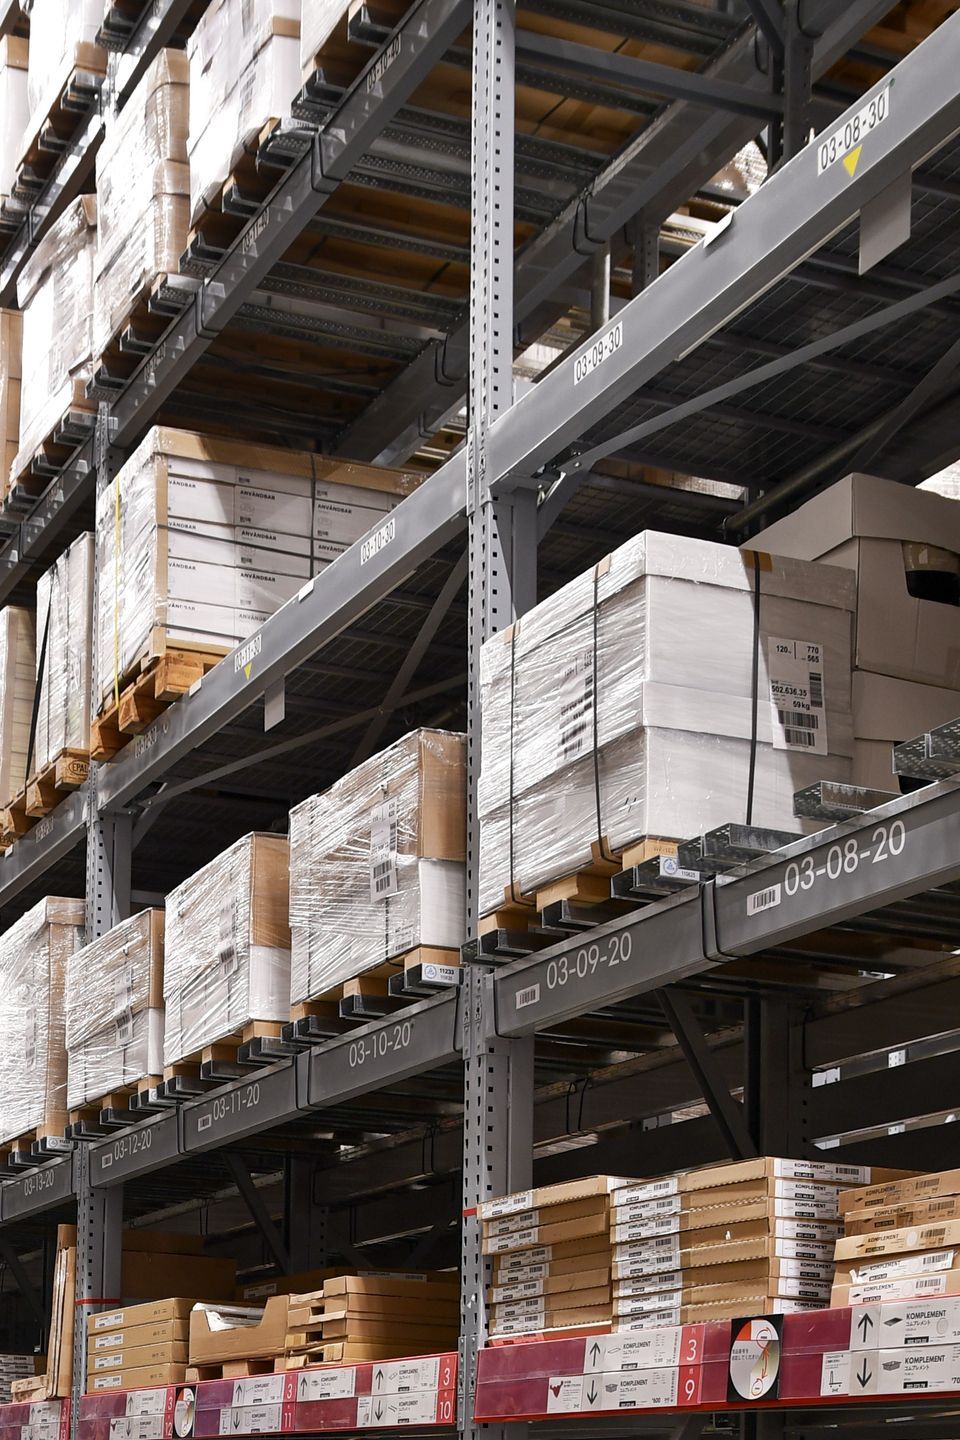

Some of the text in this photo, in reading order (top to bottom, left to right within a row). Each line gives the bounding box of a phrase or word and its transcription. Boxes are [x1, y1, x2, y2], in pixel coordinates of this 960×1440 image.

[821, 93, 885, 170] 03-08-30
[576, 326, 620, 381] 03-09-30
[362, 521, 394, 562] 03-10-30
[807, 645, 819, 654] 770
[784, 820, 906, 896] 03-08-20
[547, 932, 632, 989] 03-09-20
[439, 968, 455, 976] 11233
[349, 1022, 411, 1068] 03-10-20
[213, 1083, 260, 1121] 03-11-20
[114, 1129, 152, 1161] 03-12-20
[874, 1207, 907, 1217] KOMPLEMENT
[867, 1234, 899, 1243] KOMPLEMENT
[863, 1283, 894, 1292] KOMPLEMENT
[906, 1310, 946, 1320] KOMPLEMENT
[623, 1341, 651, 1349] KOMPLEMENT
[686, 1339, 697, 1361] 3
[904, 1355, 945, 1365] KOMPLEMENT
[443, 1367, 451, 1386] 3
[620, 1379, 648, 1387] KOMPLEMENT
[287, 1383, 293, 1399] 3
[685, 1379, 695, 1401] 9
[167, 1396, 173, 1411] 3
[440, 1401, 451, 1419] 10
[284, 1412, 292, 1428] 11
[165, 1422, 172, 1438] 12
